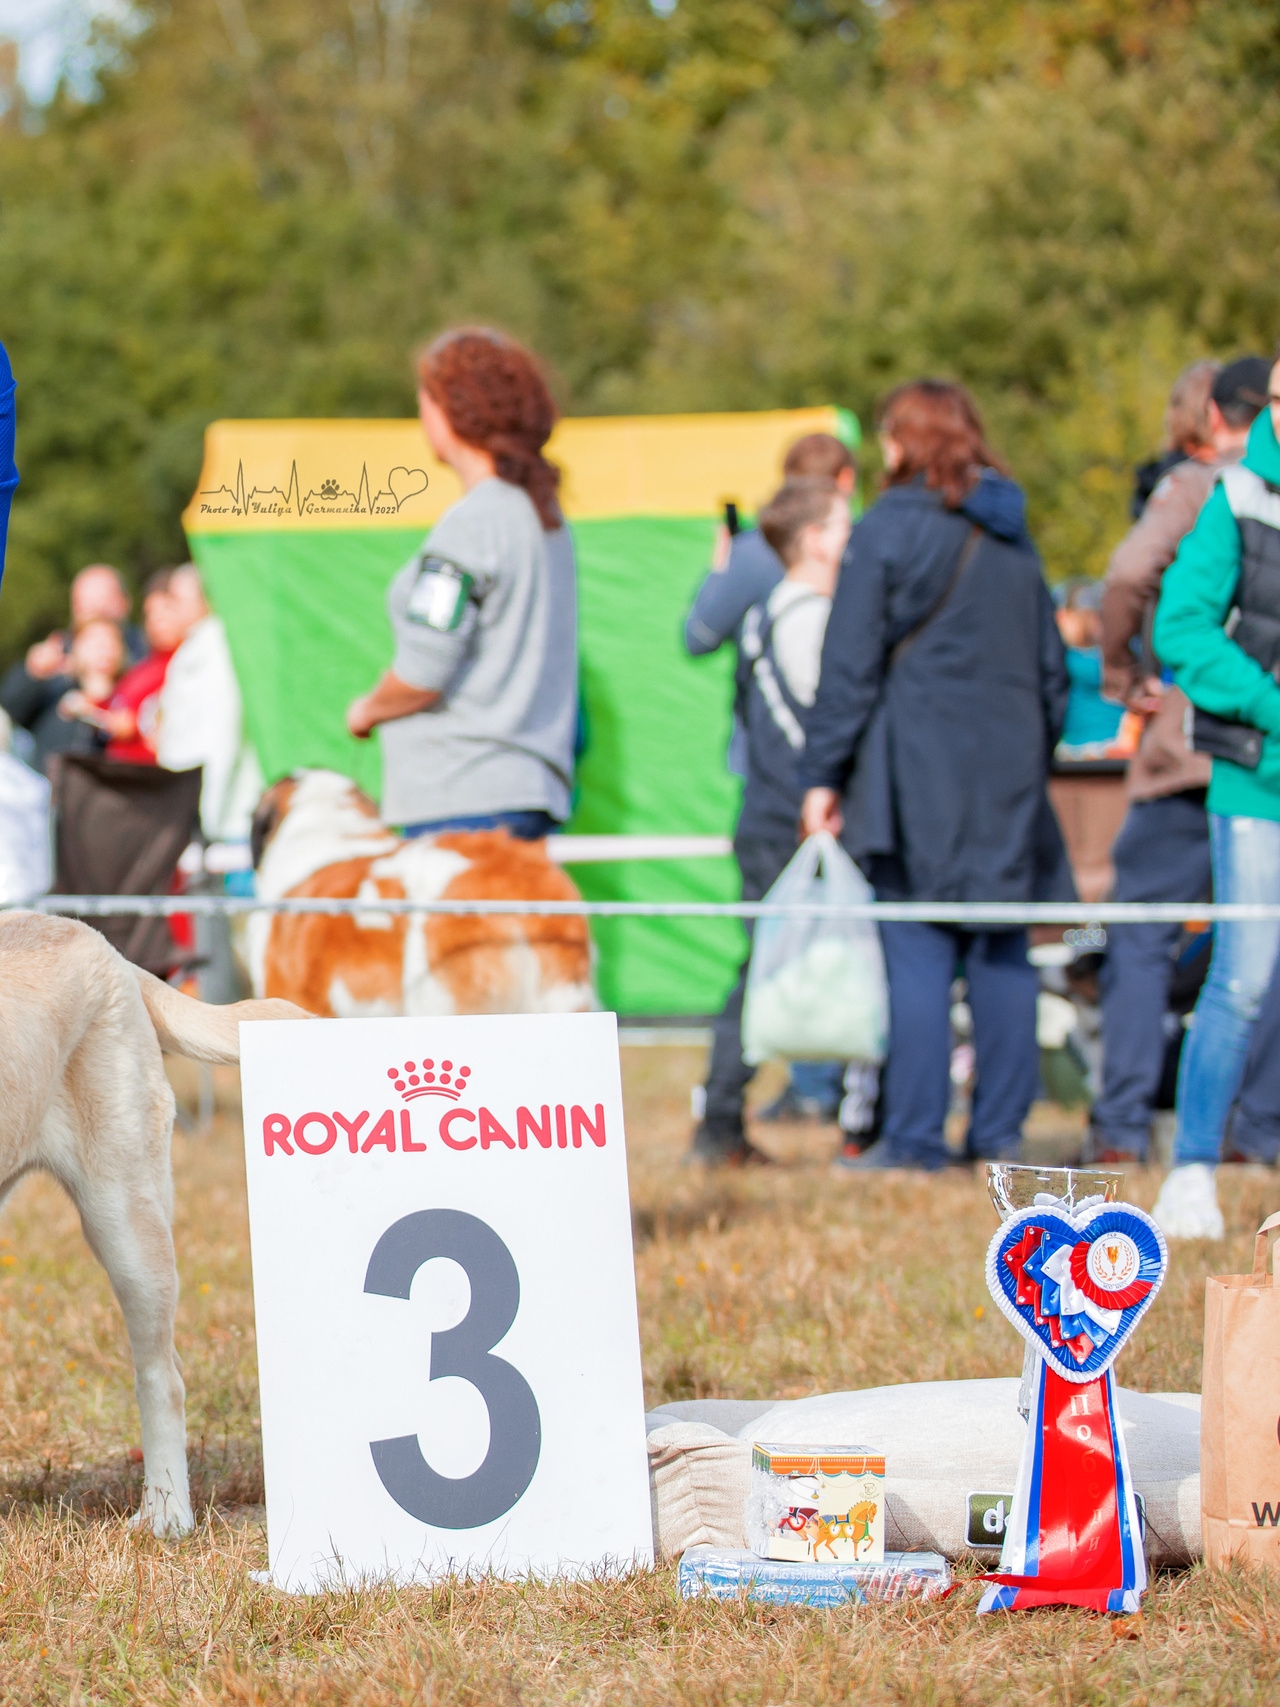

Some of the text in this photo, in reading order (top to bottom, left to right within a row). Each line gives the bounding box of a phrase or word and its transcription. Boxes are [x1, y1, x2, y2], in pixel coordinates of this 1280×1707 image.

[262, 1102, 607, 1157] ROYAL CANIN
[363, 1208, 542, 1530] 3
